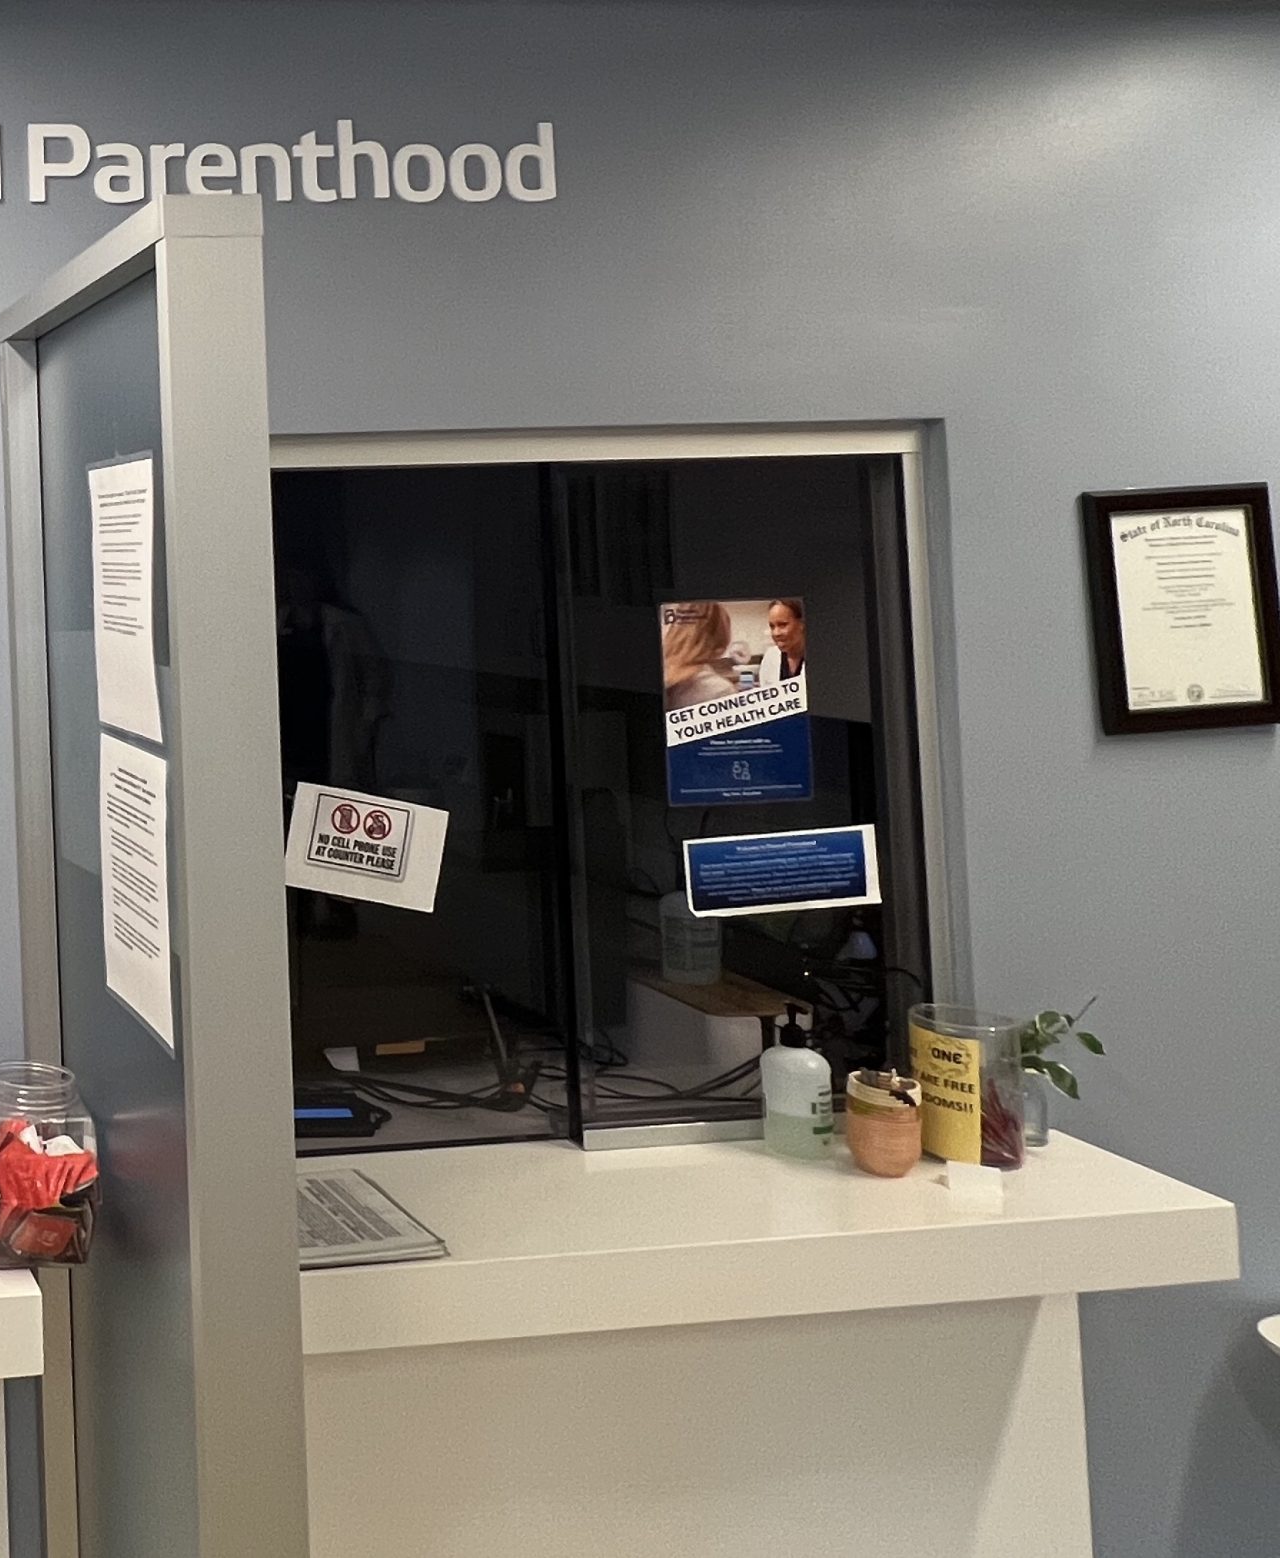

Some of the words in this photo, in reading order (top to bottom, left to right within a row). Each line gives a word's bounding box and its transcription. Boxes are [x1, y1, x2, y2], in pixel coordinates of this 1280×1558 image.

[27, 119, 557, 203] Parenthood
[1120, 524, 1147, 542] State
[1150, 518, 1160, 531] of
[1163, 516, 1193, 530] North
[1196, 515, 1240, 537] Carolina
[669, 709, 696, 725] GET
[698, 688, 779, 716] CONNECTED
[781, 681, 801, 695] TO
[674, 721, 713, 740] YOUR
[716, 708, 766, 730] HEALTH
[769, 698, 802, 716] CARE
[315, 846, 327, 857] AT
[327, 848, 365, 864] COUNTER
[365, 855, 396, 870] PLEASE
[317, 833, 330, 845] NO
[331, 835, 351, 850] CELL
[353, 839, 381, 855] PHONE
[381, 844, 398, 858] USE
[931, 1047, 962, 1065] ONE
[943, 1079, 976, 1094] FREE
